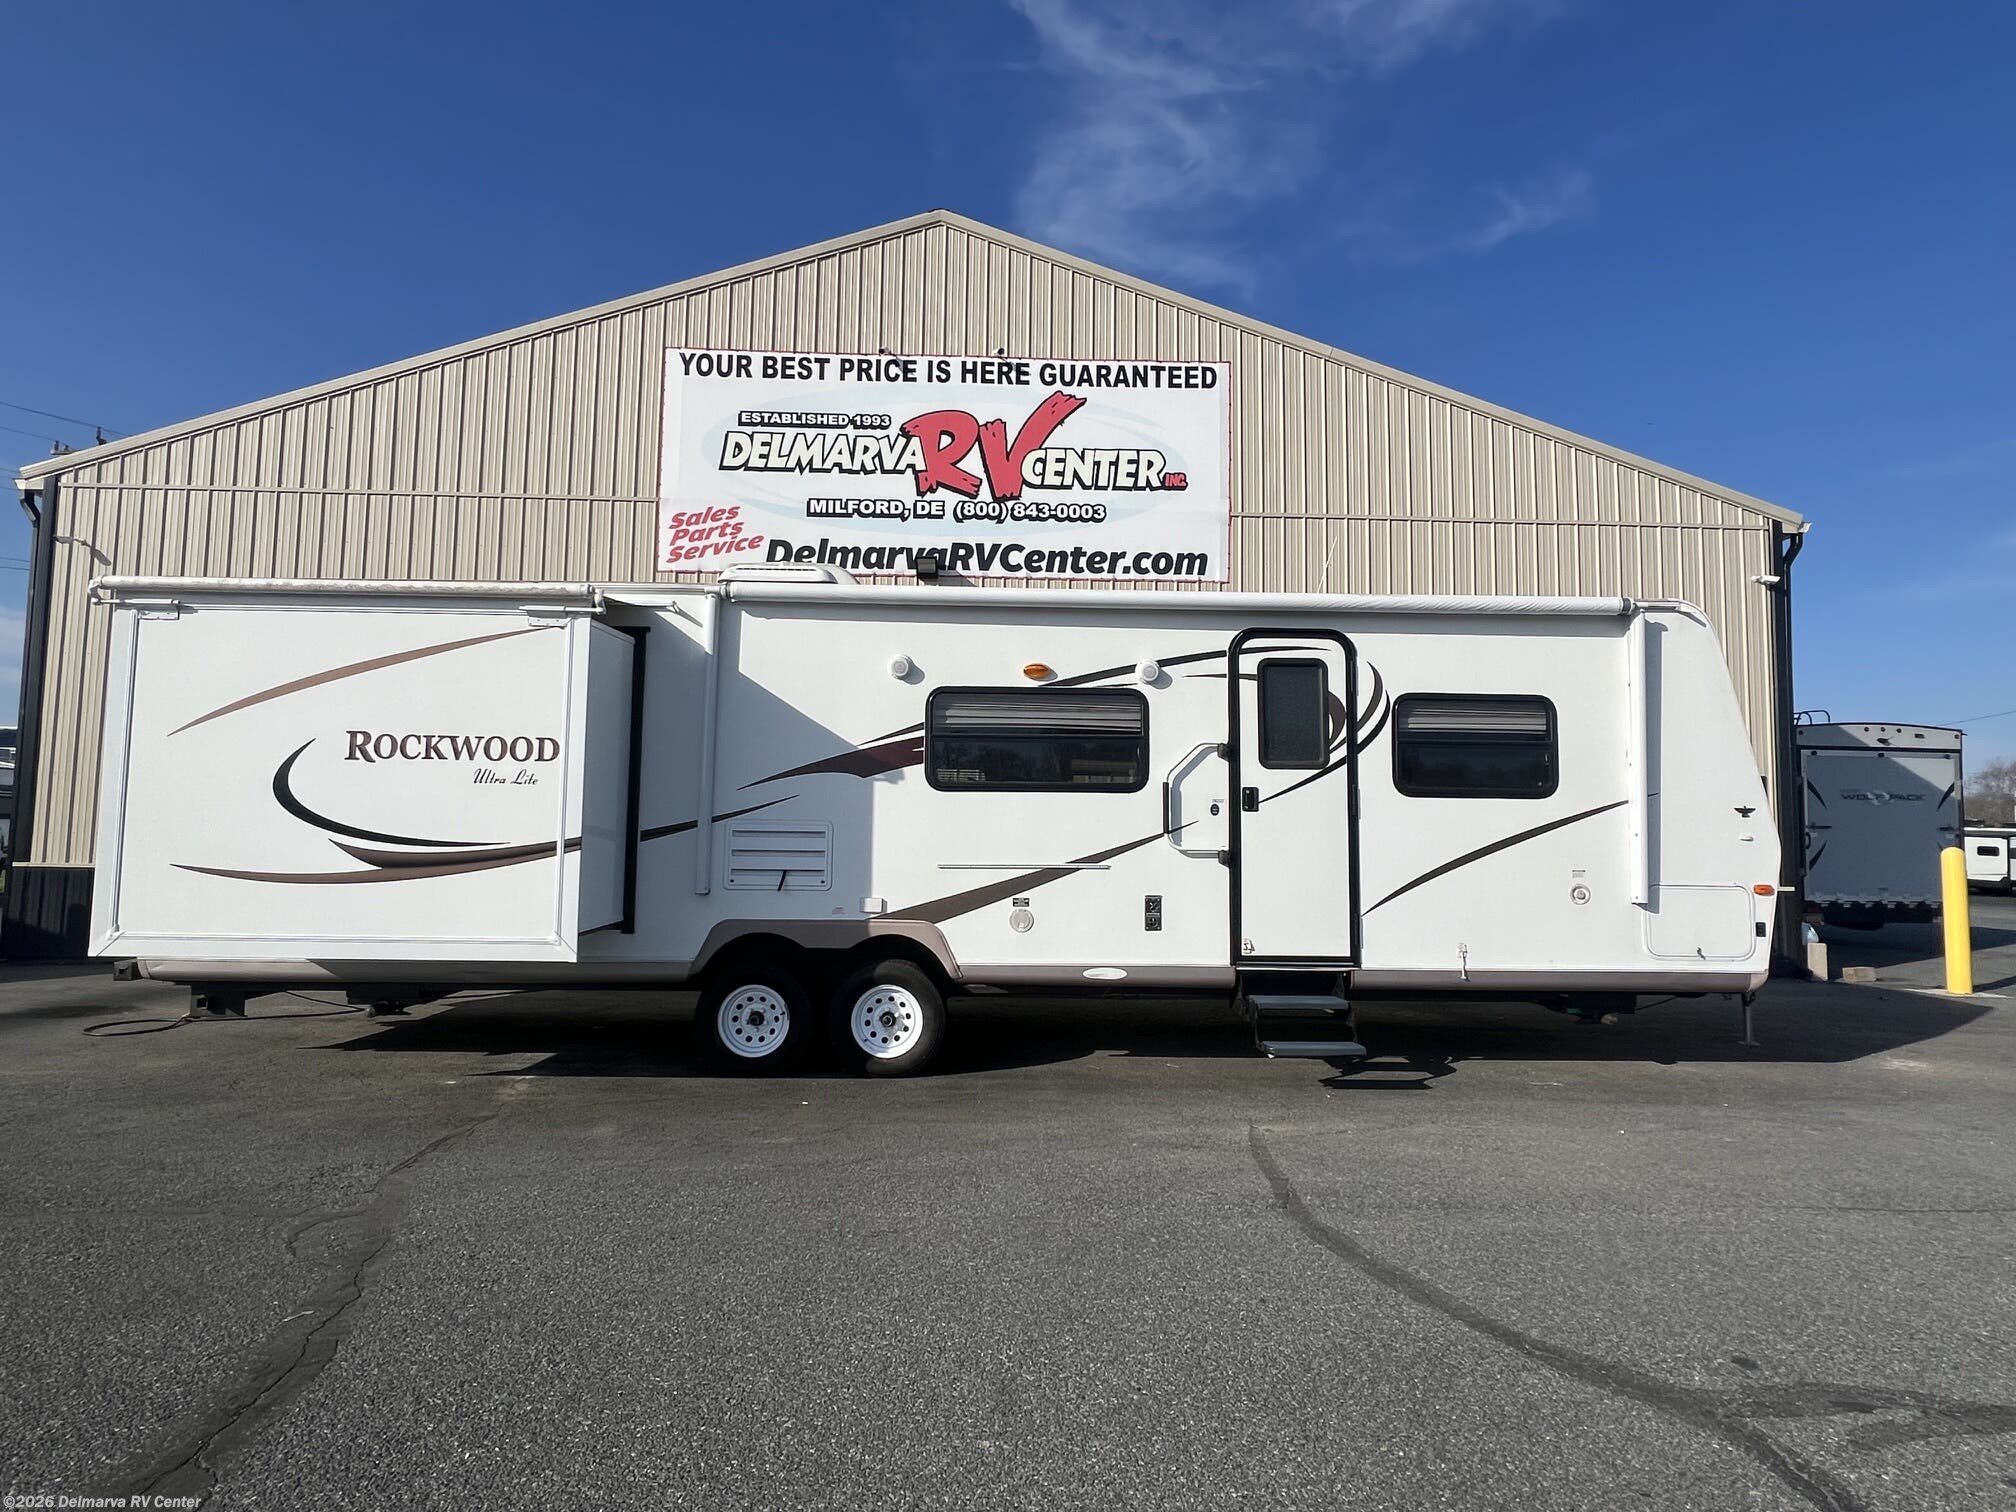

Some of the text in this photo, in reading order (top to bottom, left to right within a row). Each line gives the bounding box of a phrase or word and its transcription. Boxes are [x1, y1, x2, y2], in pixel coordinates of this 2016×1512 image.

[680, 353, 1217, 389] YOUR BEST PRICE IS HERE GUARANTEED
[740, 412, 891, 428] ESTABLISHED 1993
[720, 431, 928, 474] DELMARVA
[900, 391, 1087, 500] RV
[1021, 448, 1166, 490] CENTER
[669, 506, 740, 530] Sales
[808, 500, 1106, 521] MILFORD, DE (800) 843-0003
[670, 520, 745, 546] Parts
[666, 534, 765, 564] Service
[766, 538, 1208, 576] DelmarvaRVCenter.com
[345, 730, 560, 763] ROCKWOOD
[473, 768, 539, 785] Ultra Lite
